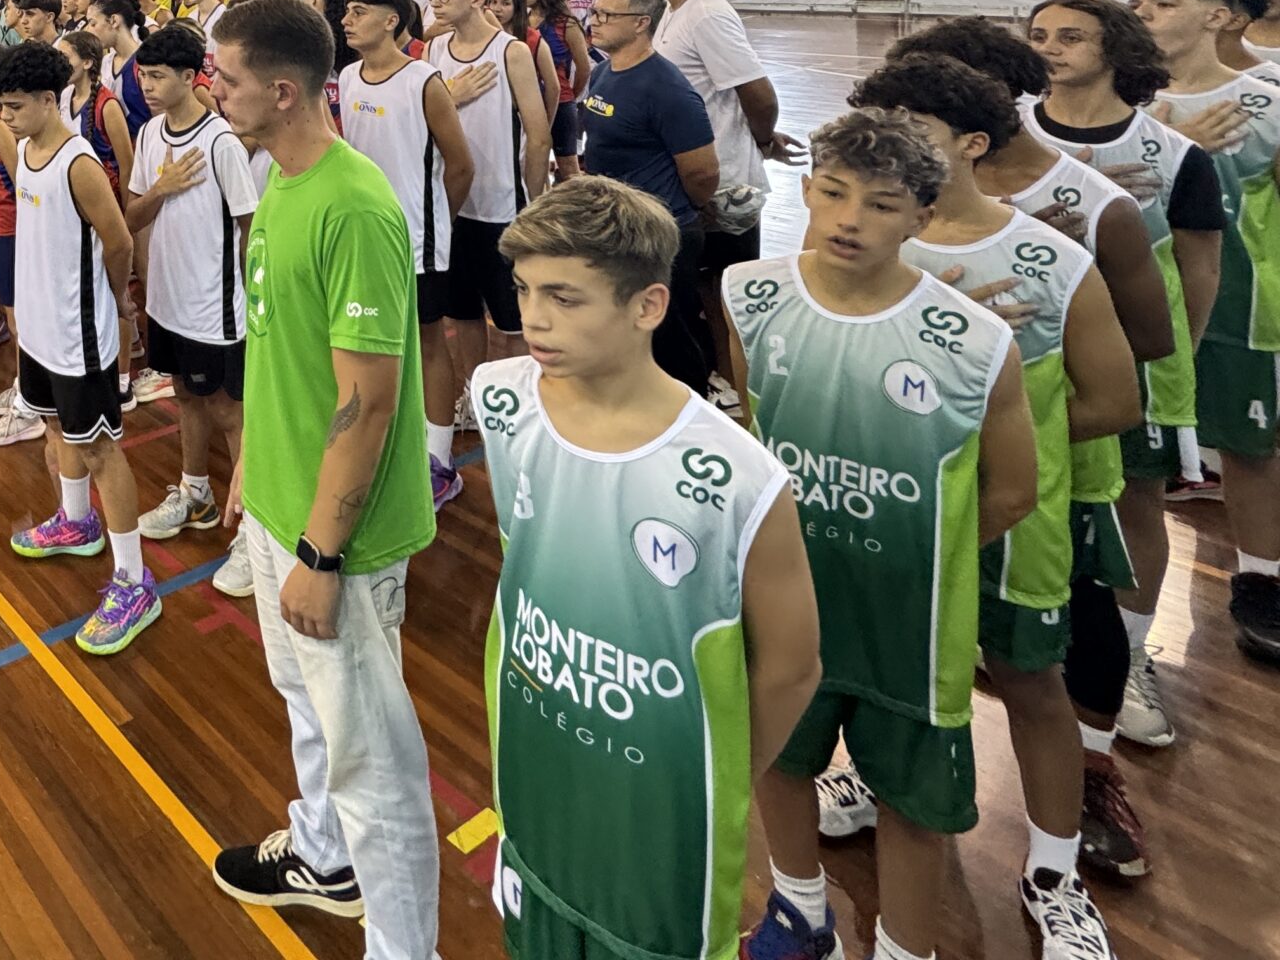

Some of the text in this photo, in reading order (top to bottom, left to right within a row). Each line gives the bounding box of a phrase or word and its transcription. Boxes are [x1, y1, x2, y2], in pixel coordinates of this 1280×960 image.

[1012, 263, 1051, 283] COC
[769, 334, 789, 377] 2
[919, 329, 964, 354] COC
[903, 374, 926, 402] M
[1248, 399, 1267, 429] 4
[676, 479, 725, 512] COC
[791, 473, 875, 520] BATO
[653, 535, 677, 571] M
[806, 521, 882, 552] ÉGIO
[516, 587, 684, 698] MONTEIRO
[511, 621, 634, 720] LOBATO
[507, 670, 644, 764] COLÉGIO
